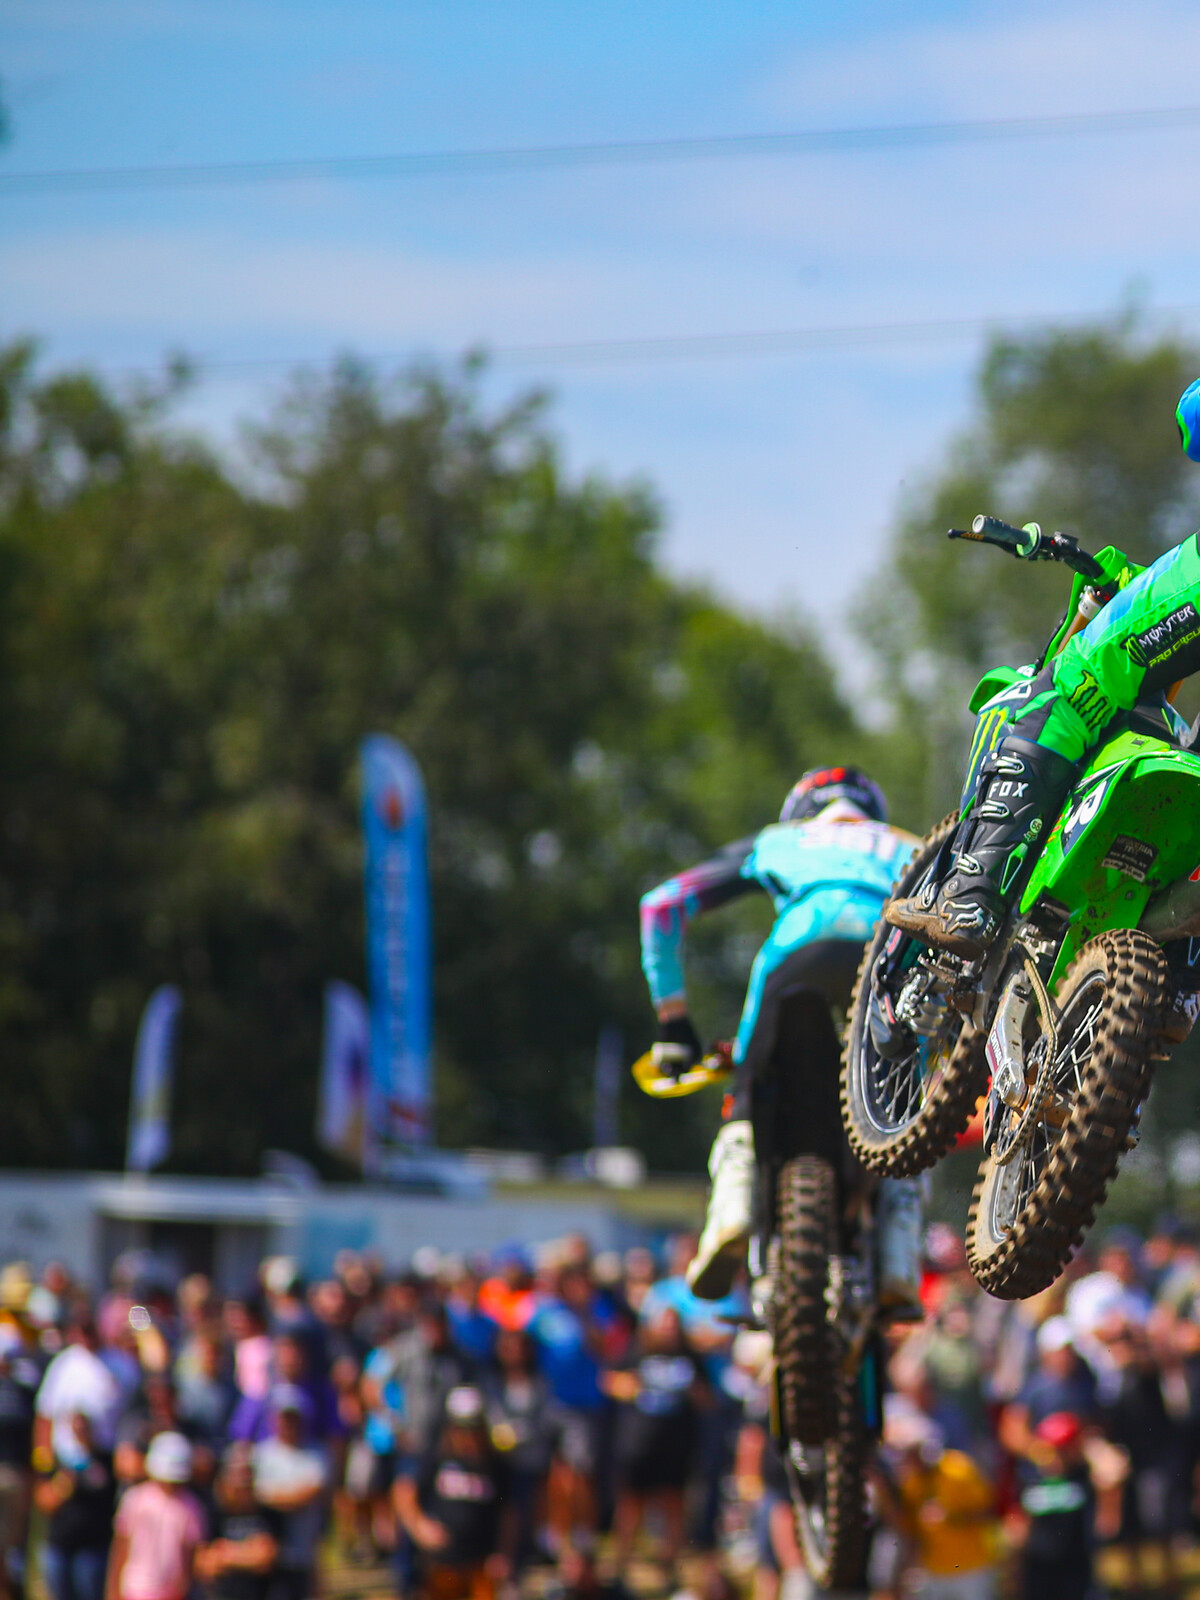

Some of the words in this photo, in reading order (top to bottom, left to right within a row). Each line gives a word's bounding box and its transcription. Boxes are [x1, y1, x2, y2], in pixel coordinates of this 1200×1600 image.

[1138, 605, 1195, 648] MONSTER
[1148, 648, 1173, 668] PRO
[988, 781, 1029, 798] FOX
[1172, 990, 1185, 1013] FOX
